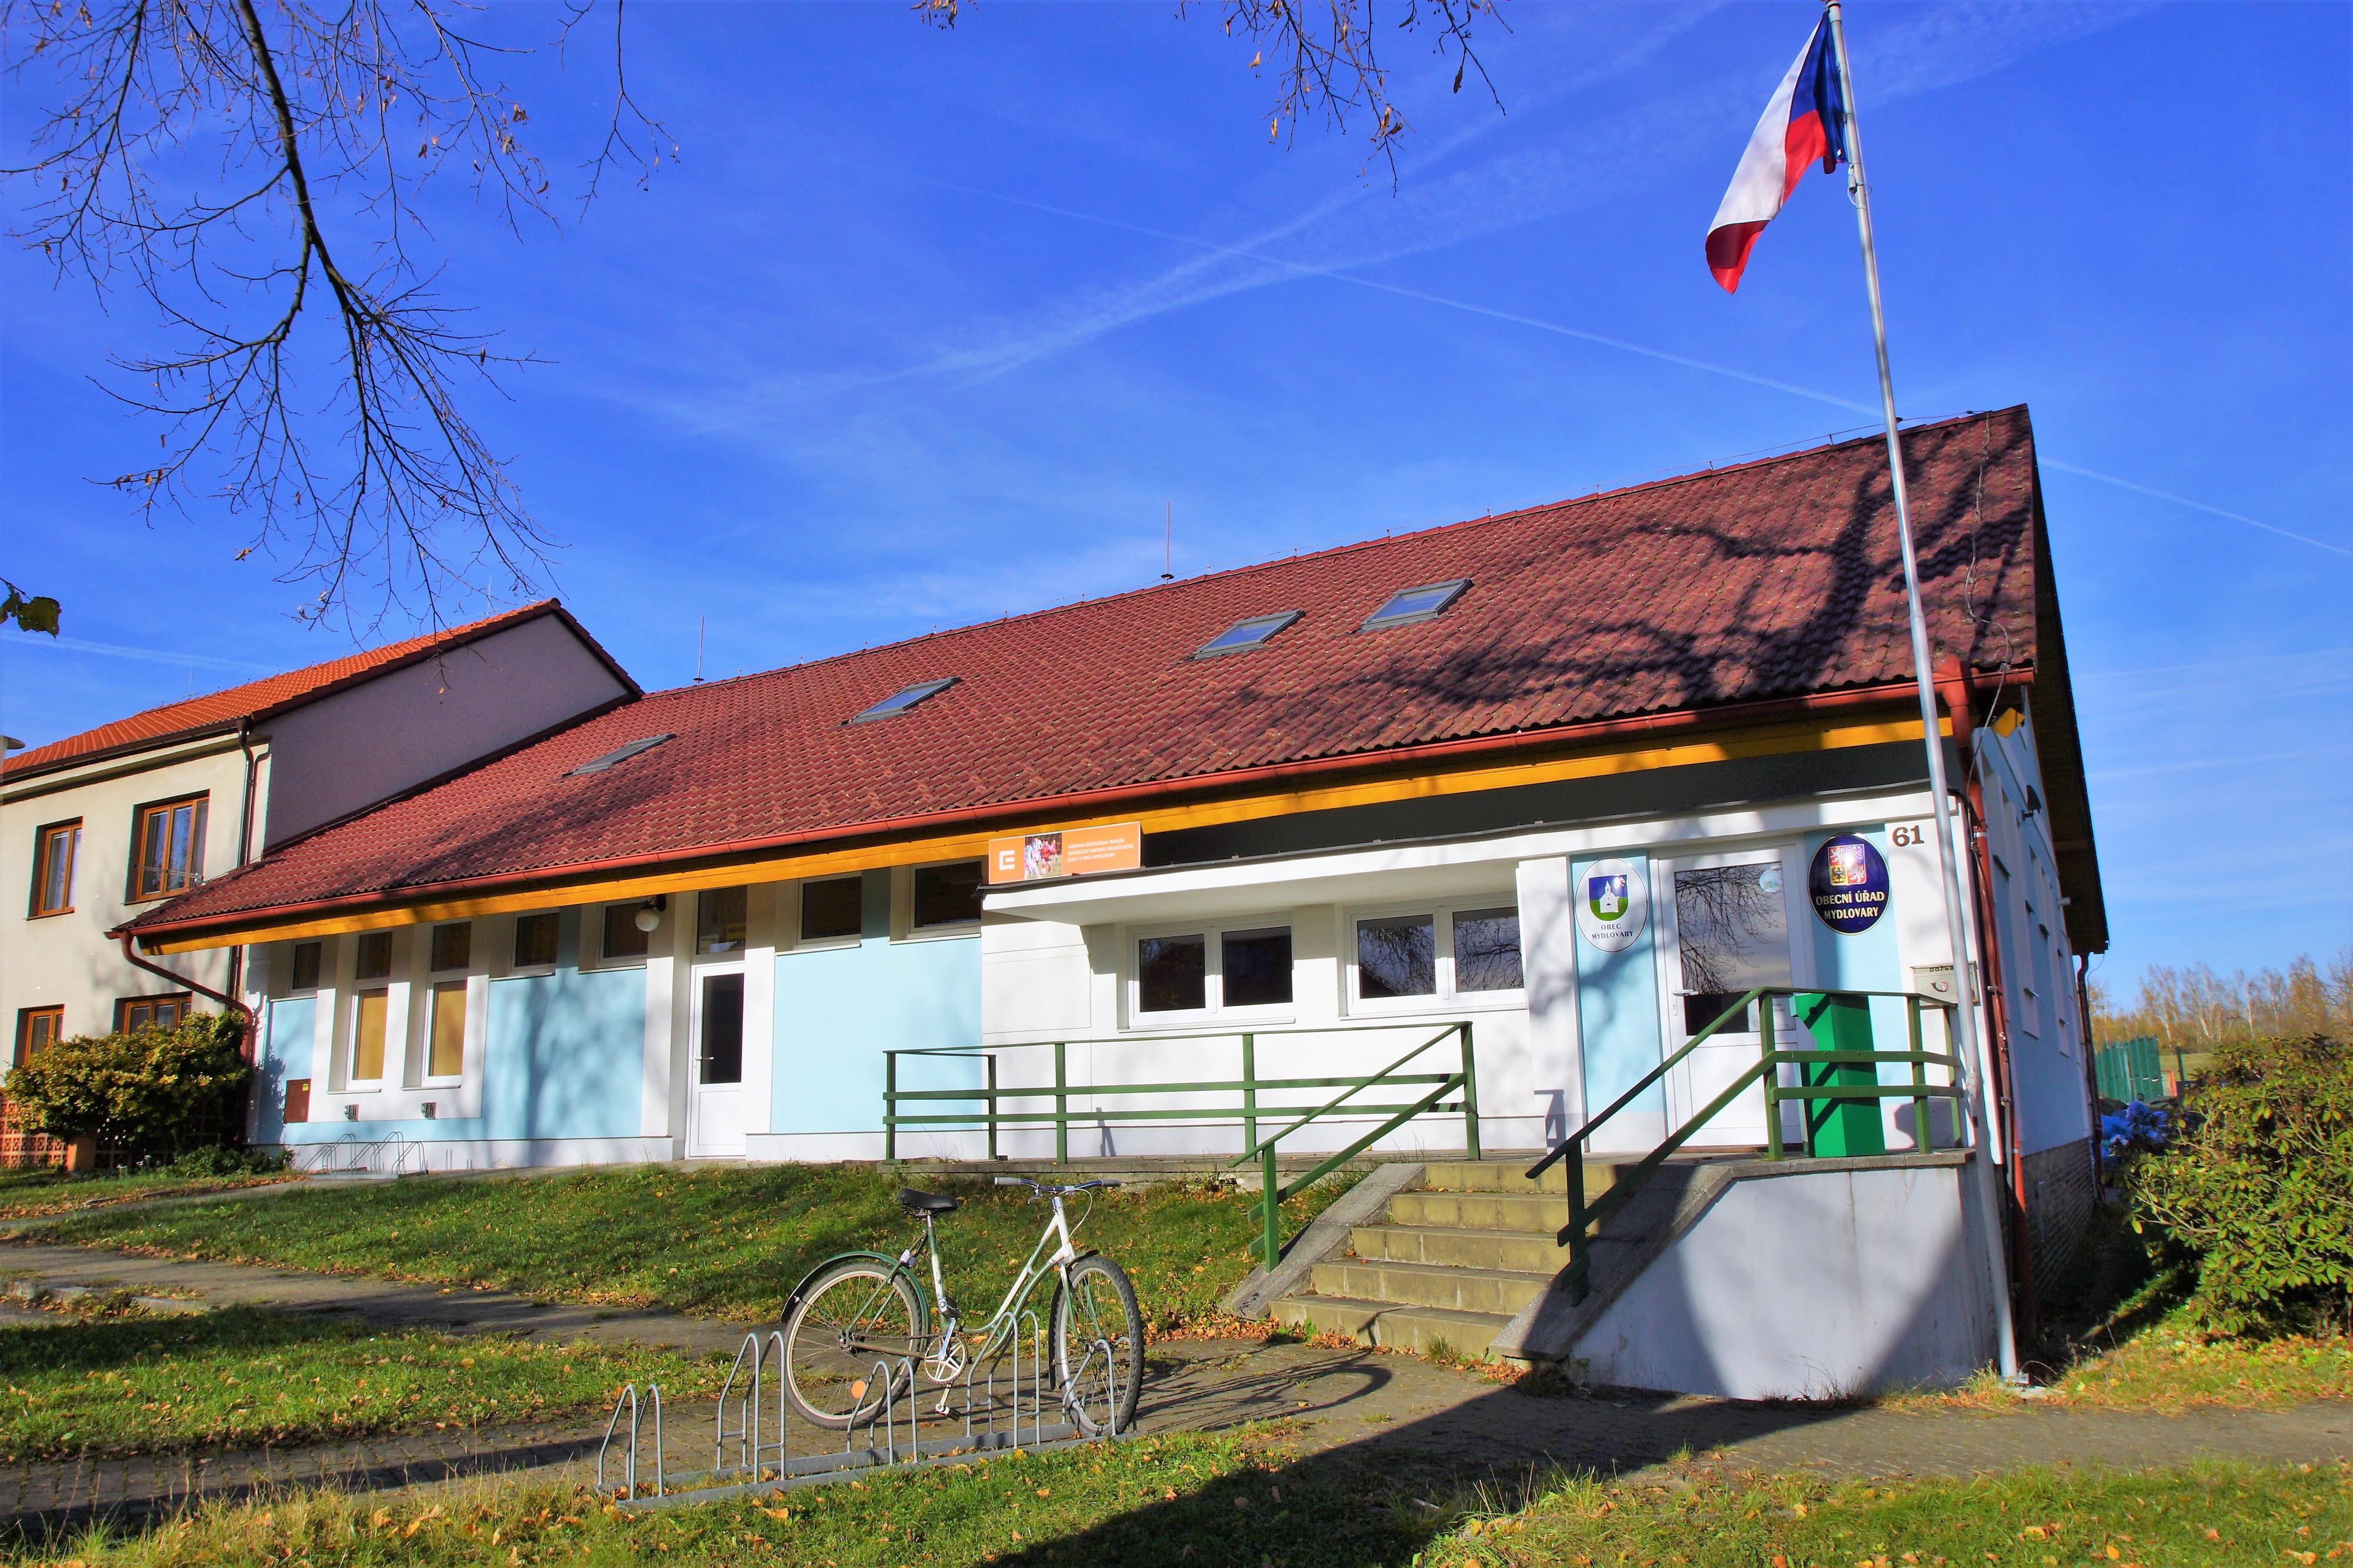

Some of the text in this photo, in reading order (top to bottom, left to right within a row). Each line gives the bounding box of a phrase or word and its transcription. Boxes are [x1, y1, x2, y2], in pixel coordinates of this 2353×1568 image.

[1892, 825, 1924, 847] 61
[1815, 889, 1885, 905] OBECNÍ ÚŘAD
[1824, 906, 1878, 920] MYDLOVARY
[1591, 930, 1633, 939] MYDLOVARY
